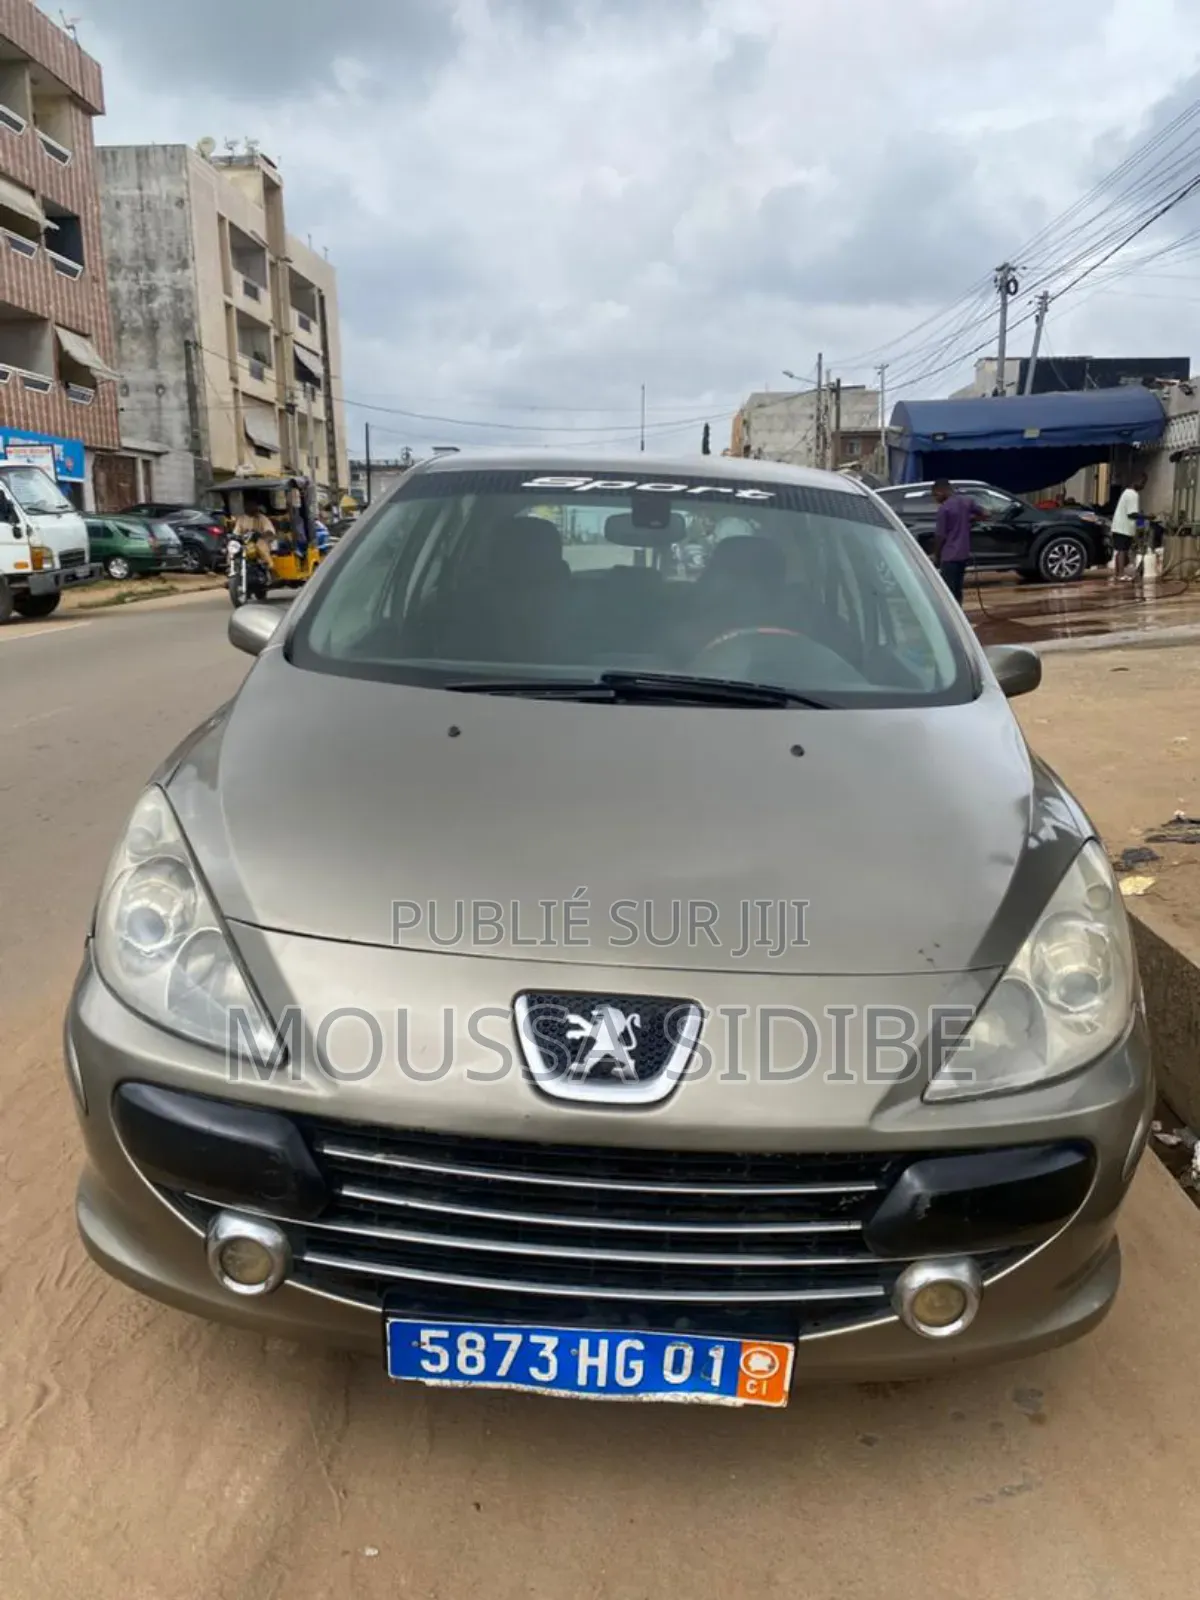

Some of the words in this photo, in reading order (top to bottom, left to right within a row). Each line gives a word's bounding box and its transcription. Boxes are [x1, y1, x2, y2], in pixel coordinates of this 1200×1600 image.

[521, 476, 776, 499] Sport
[419, 1329, 559, 1382] 5873
[577, 1338, 645, 1388] HG
[663, 1341, 725, 1388] 01
[745, 1379, 768, 1397] CI
